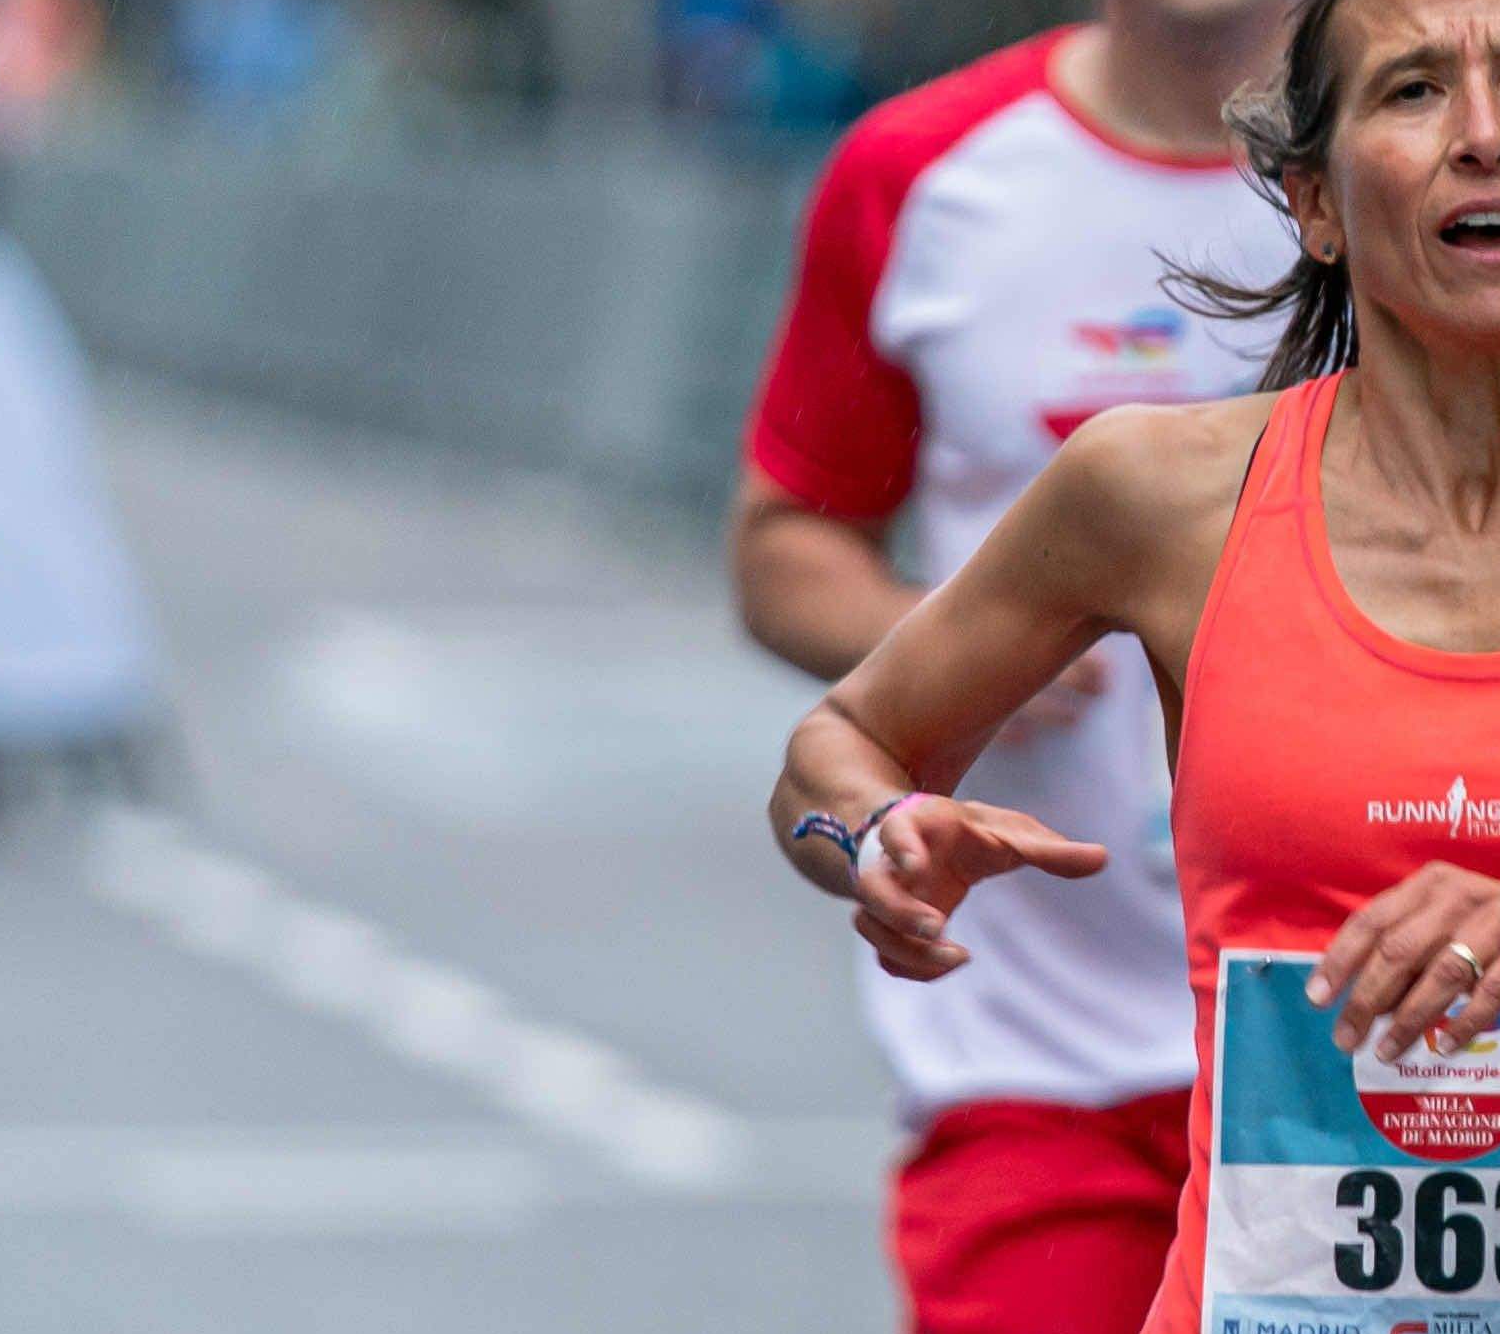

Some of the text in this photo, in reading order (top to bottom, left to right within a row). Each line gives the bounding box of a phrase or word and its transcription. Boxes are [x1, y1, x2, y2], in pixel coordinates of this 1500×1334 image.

[1421, 1096, 1474, 1112] MILLA
[1402, 1130, 1494, 1146] DE MADRID
